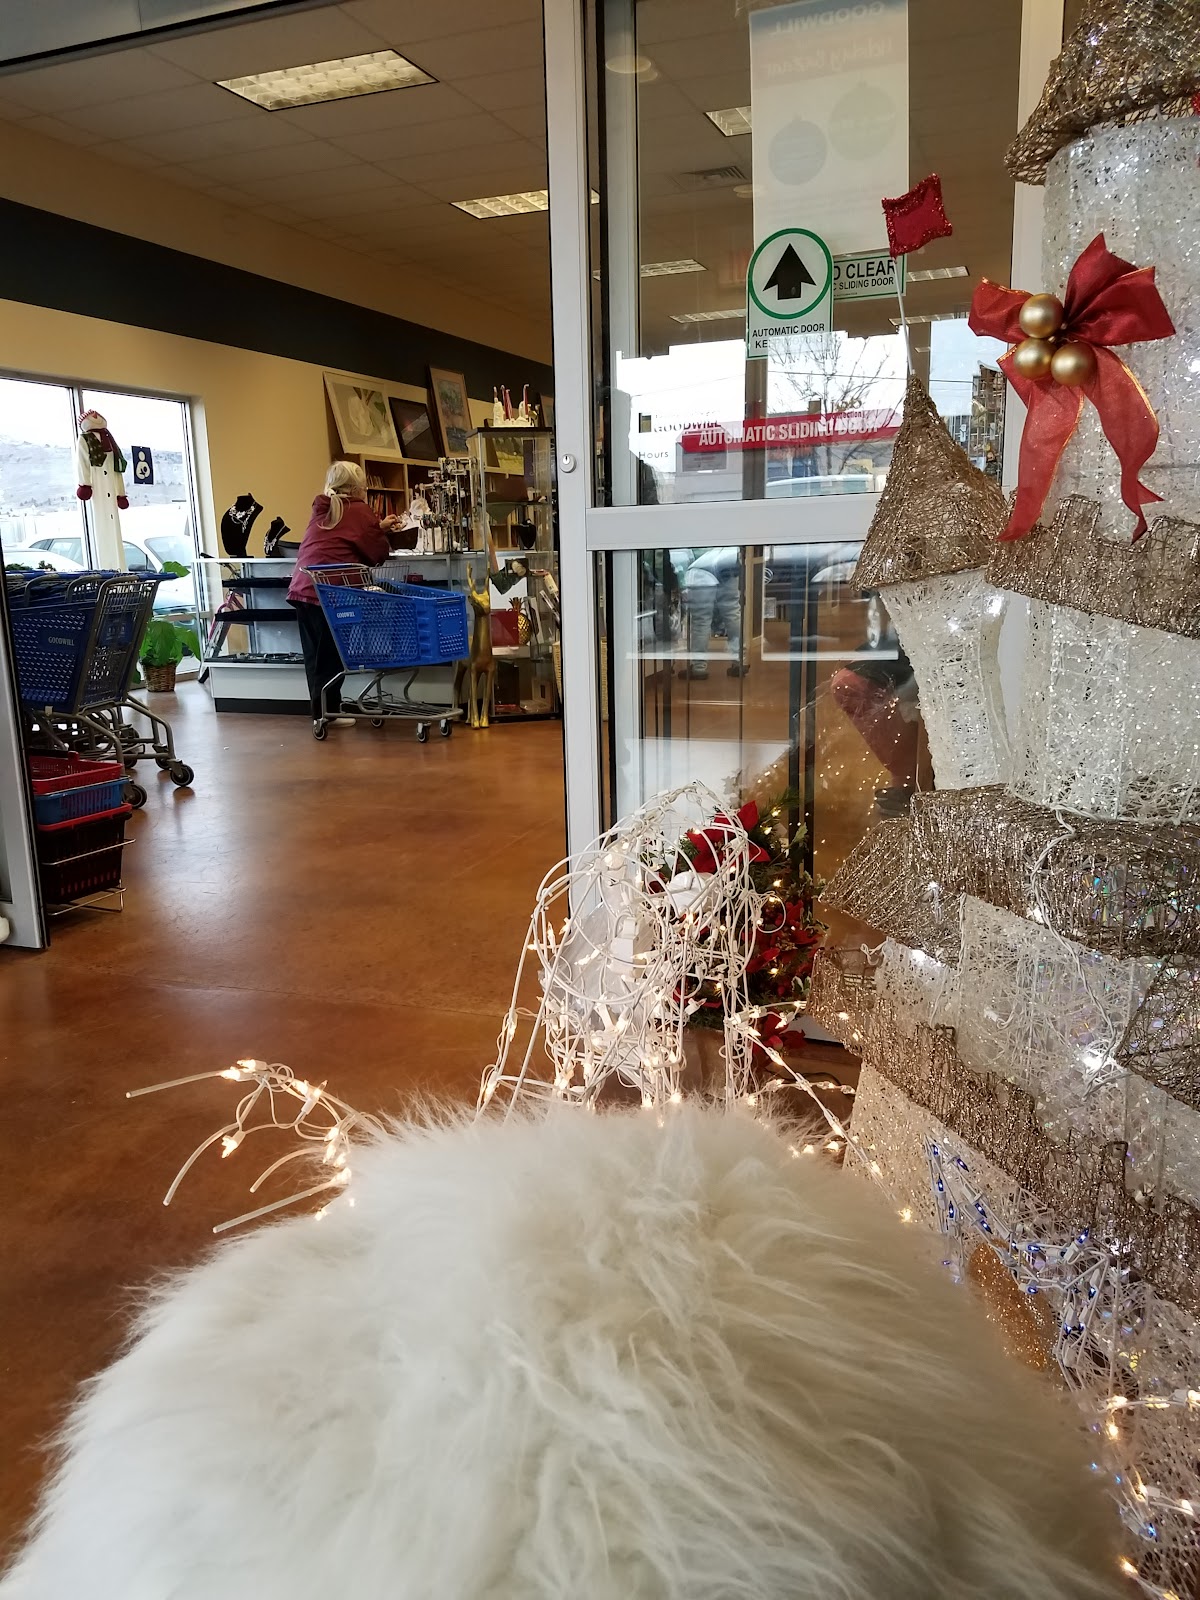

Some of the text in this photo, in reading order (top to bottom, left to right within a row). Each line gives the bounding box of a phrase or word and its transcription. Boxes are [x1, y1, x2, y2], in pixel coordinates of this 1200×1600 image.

[846, 260, 896, 279] CLEAR
[839, 279, 869, 290] SLIDING
[871, 276, 894, 287] DOOR
[752, 323, 825, 338] AUTOMATIC DOOR
[654, 419, 721, 433] GOODWILL
[779, 419, 834, 439] SLIDING
[639, 451, 669, 460] Hours
[48, 636, 75, 647] GOODWILL
